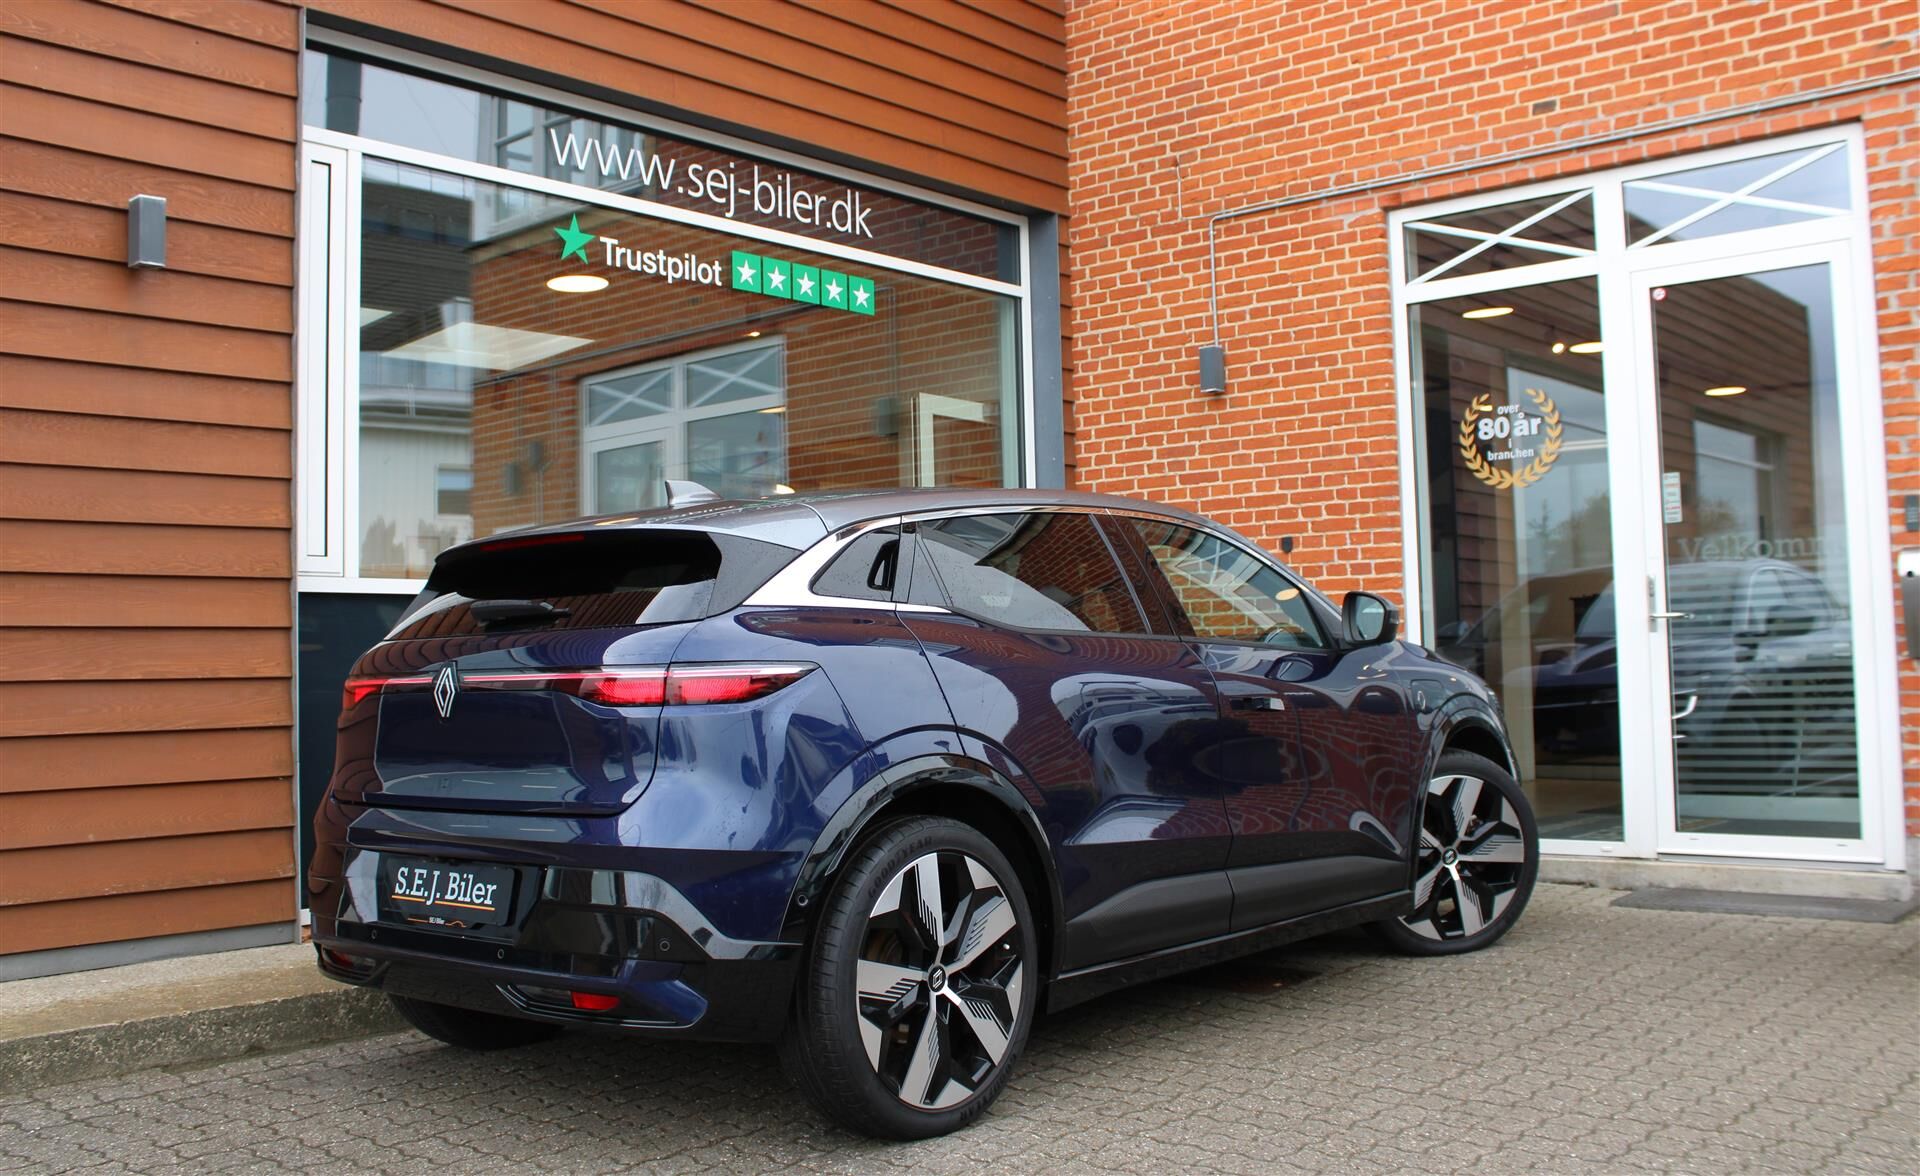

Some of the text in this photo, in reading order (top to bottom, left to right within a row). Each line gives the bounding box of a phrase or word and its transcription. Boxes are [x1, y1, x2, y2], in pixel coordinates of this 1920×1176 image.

[550, 127, 873, 239] www.sej-biler.dk
[600, 236, 722, 287] Trustpilot
[1497, 404, 1520, 414] over
[1478, 412, 1541, 440] 80 år
[1487, 448, 1534, 461] branchen
[395, 866, 497, 905] S.E.J. Biler
